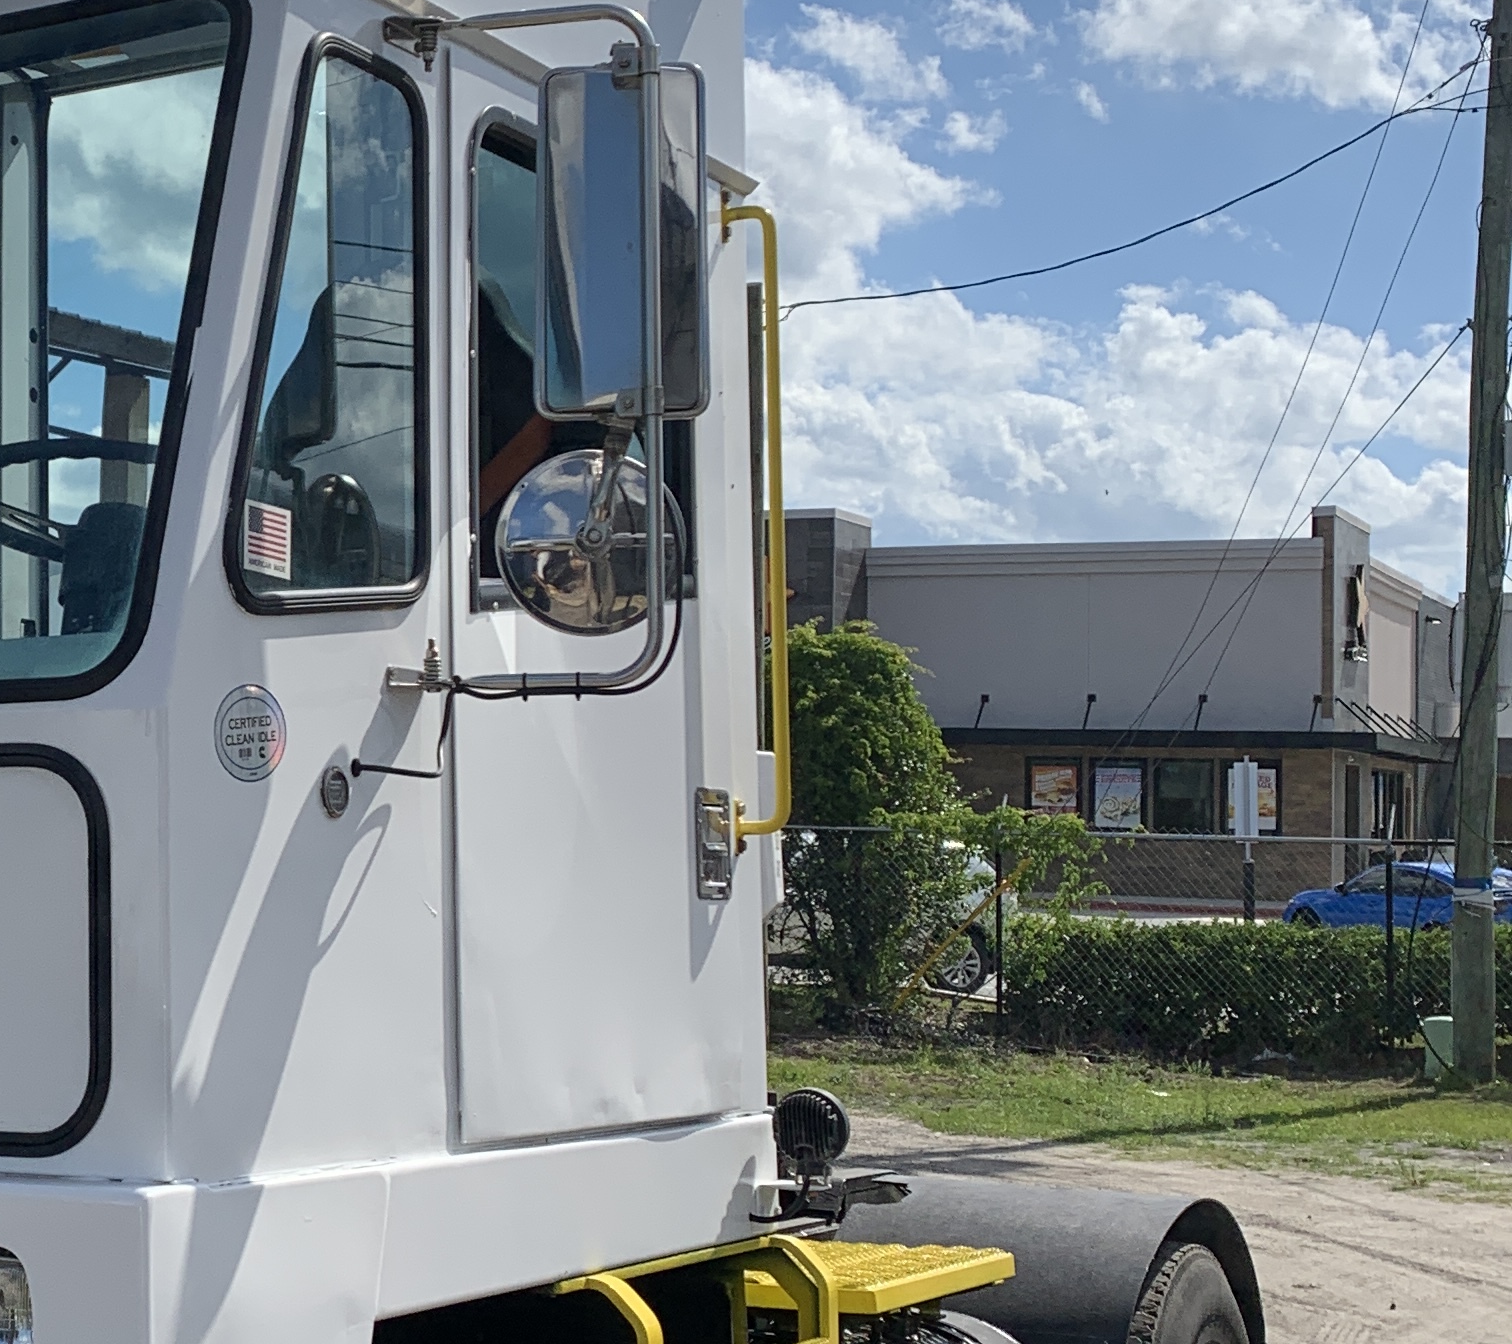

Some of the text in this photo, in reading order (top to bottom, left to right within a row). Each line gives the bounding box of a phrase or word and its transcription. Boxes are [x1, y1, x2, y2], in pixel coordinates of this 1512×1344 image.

[228, 715, 272, 730] CERTIFIED
[225, 730, 277, 746] CLEAN IDLE
